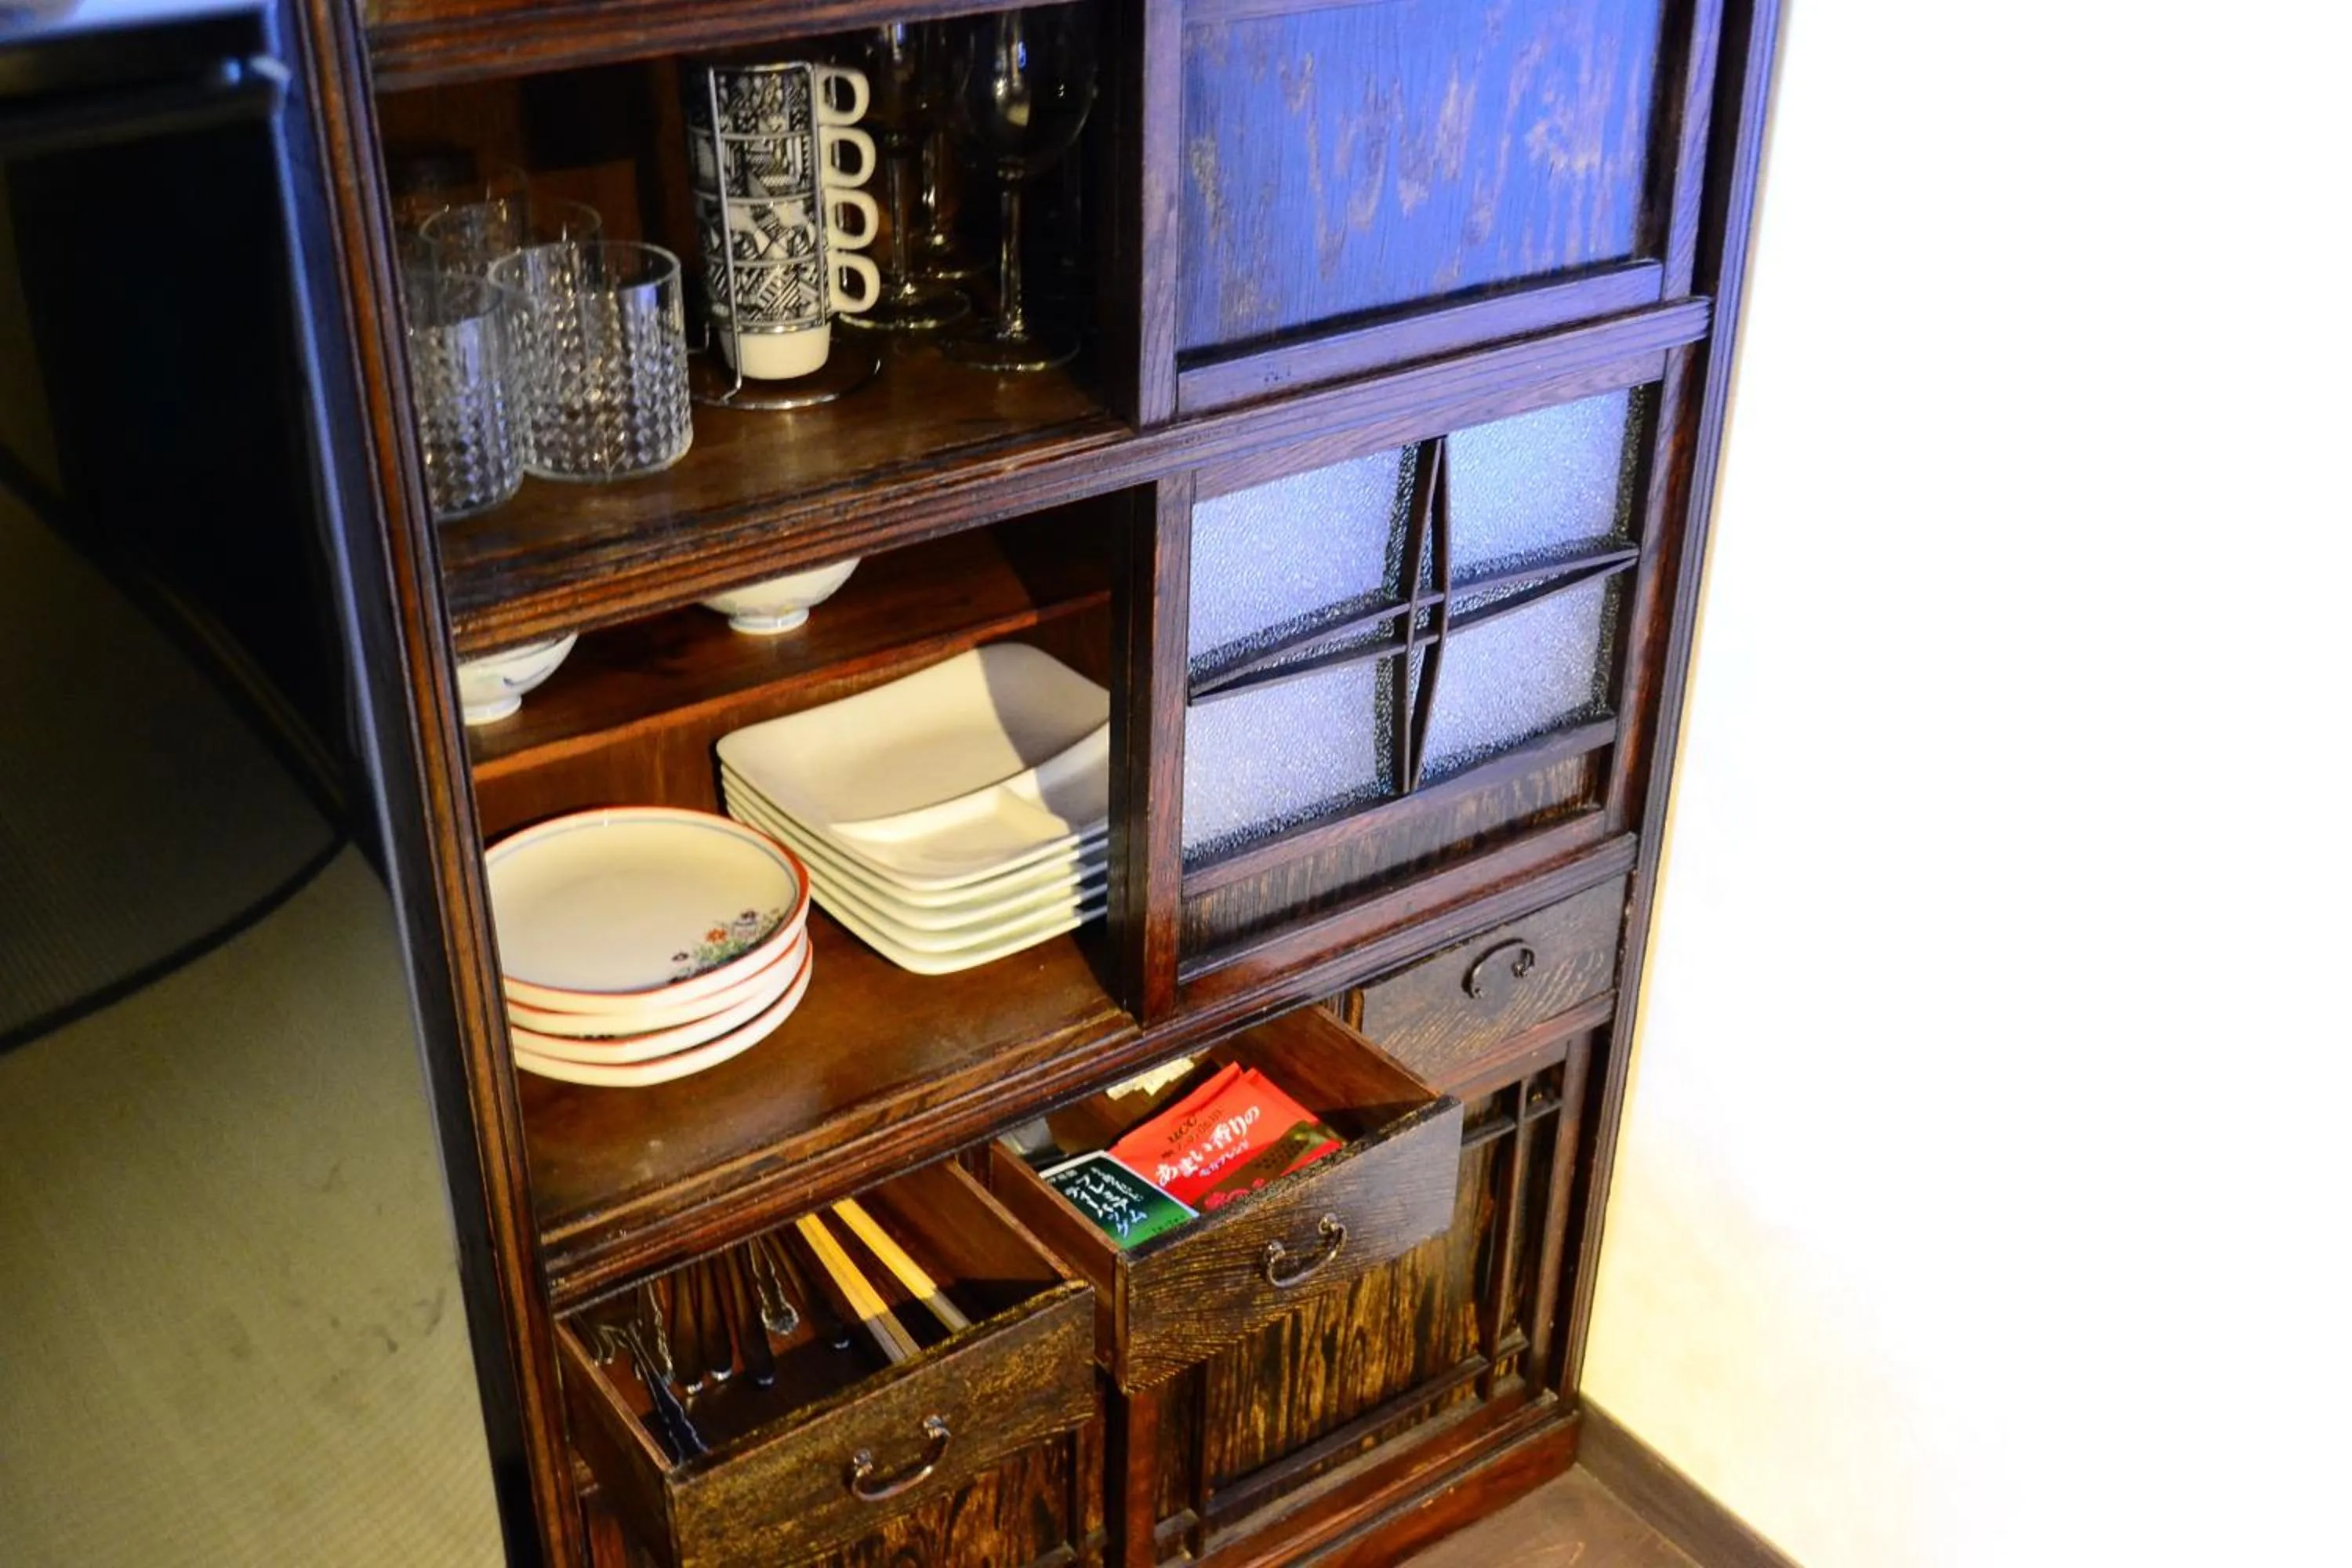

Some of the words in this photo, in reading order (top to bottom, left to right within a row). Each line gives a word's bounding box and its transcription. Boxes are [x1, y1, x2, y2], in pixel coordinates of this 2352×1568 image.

[1156, 1105, 1261, 1187] あまい香りの
